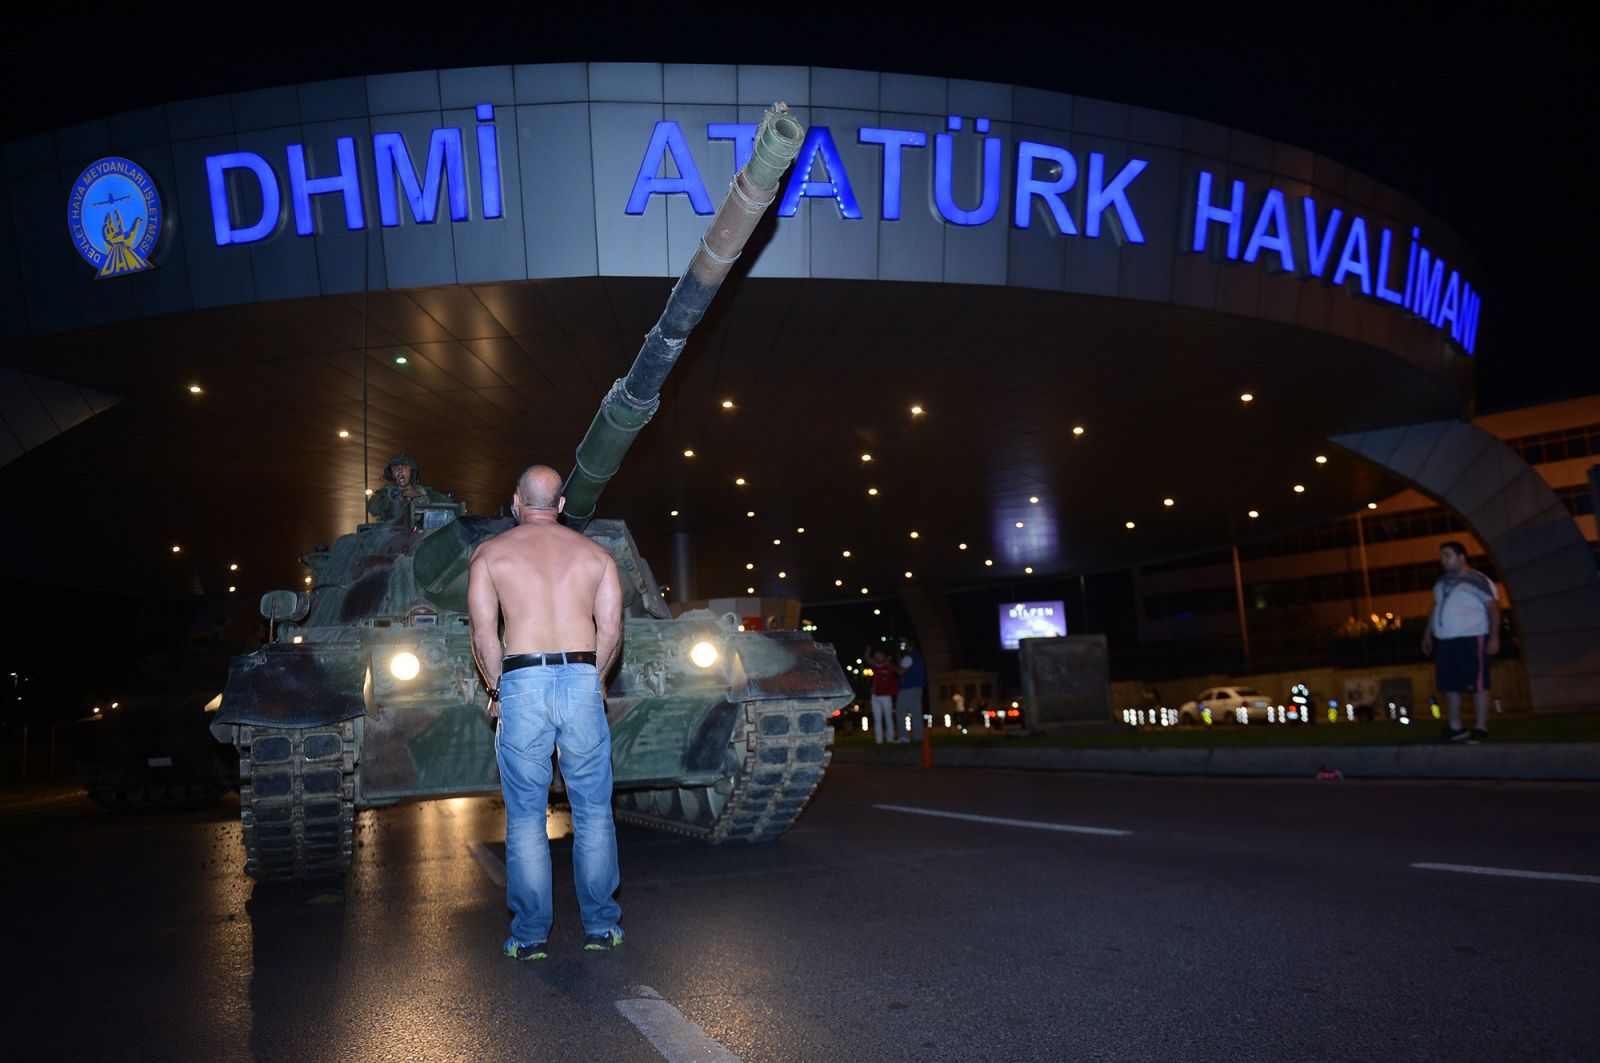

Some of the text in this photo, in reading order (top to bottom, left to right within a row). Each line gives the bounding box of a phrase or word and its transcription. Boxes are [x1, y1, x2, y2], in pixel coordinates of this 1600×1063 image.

[83, 162, 145, 187] MEYDANLARI
[72, 186, 86, 219] HAVA
[72, 224, 101, 263] DEVLET
[205, 103, 1481, 355] DHMİ ATATÜRK HAVALİMANI
